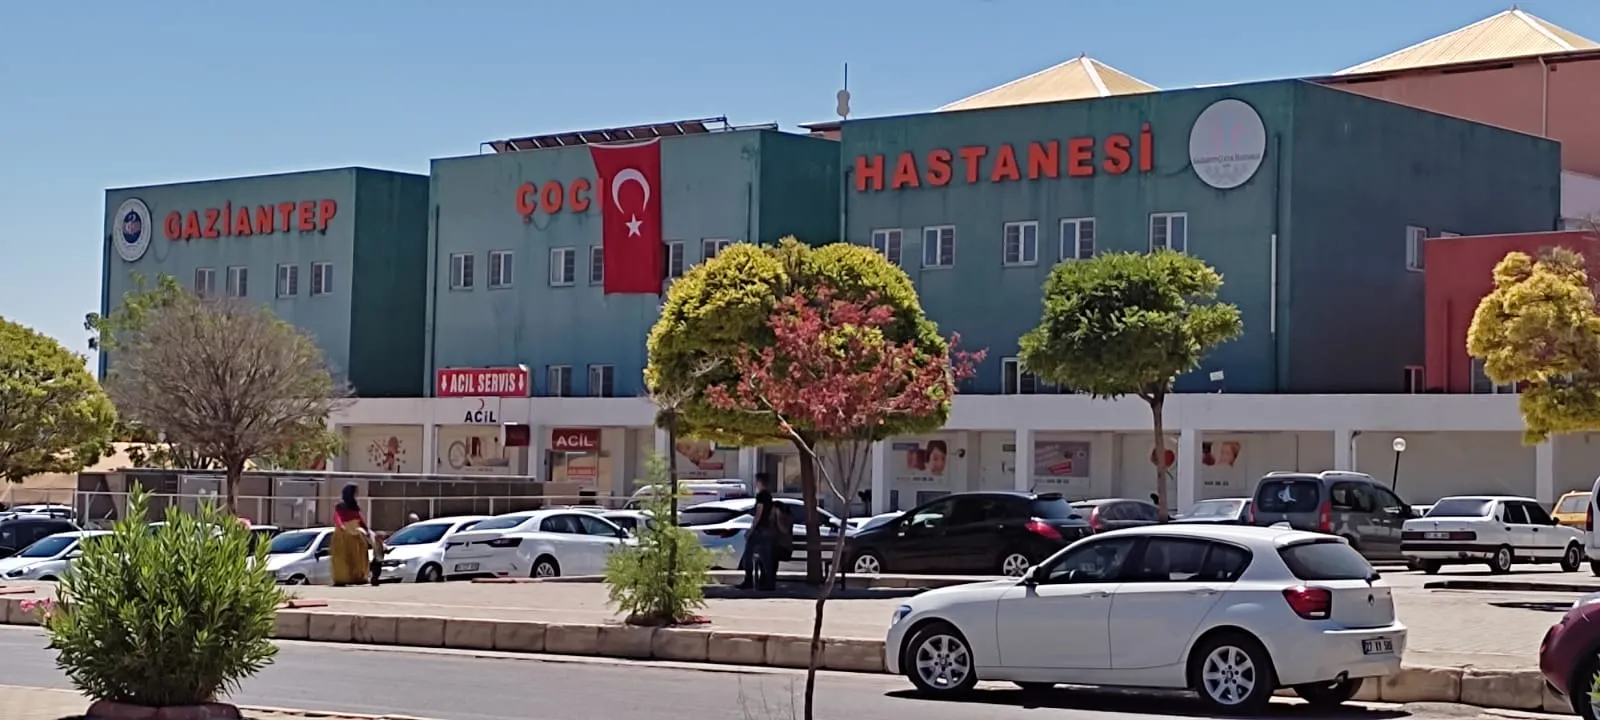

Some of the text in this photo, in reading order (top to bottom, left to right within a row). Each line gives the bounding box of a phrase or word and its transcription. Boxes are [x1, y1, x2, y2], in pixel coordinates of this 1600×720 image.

[163, 199, 337, 241] GAZİANTEP
[516, 177, 603, 223] ÇOC
[855, 122, 1153, 192] HASTANESİ
[556, 433, 594, 447] ACİL
